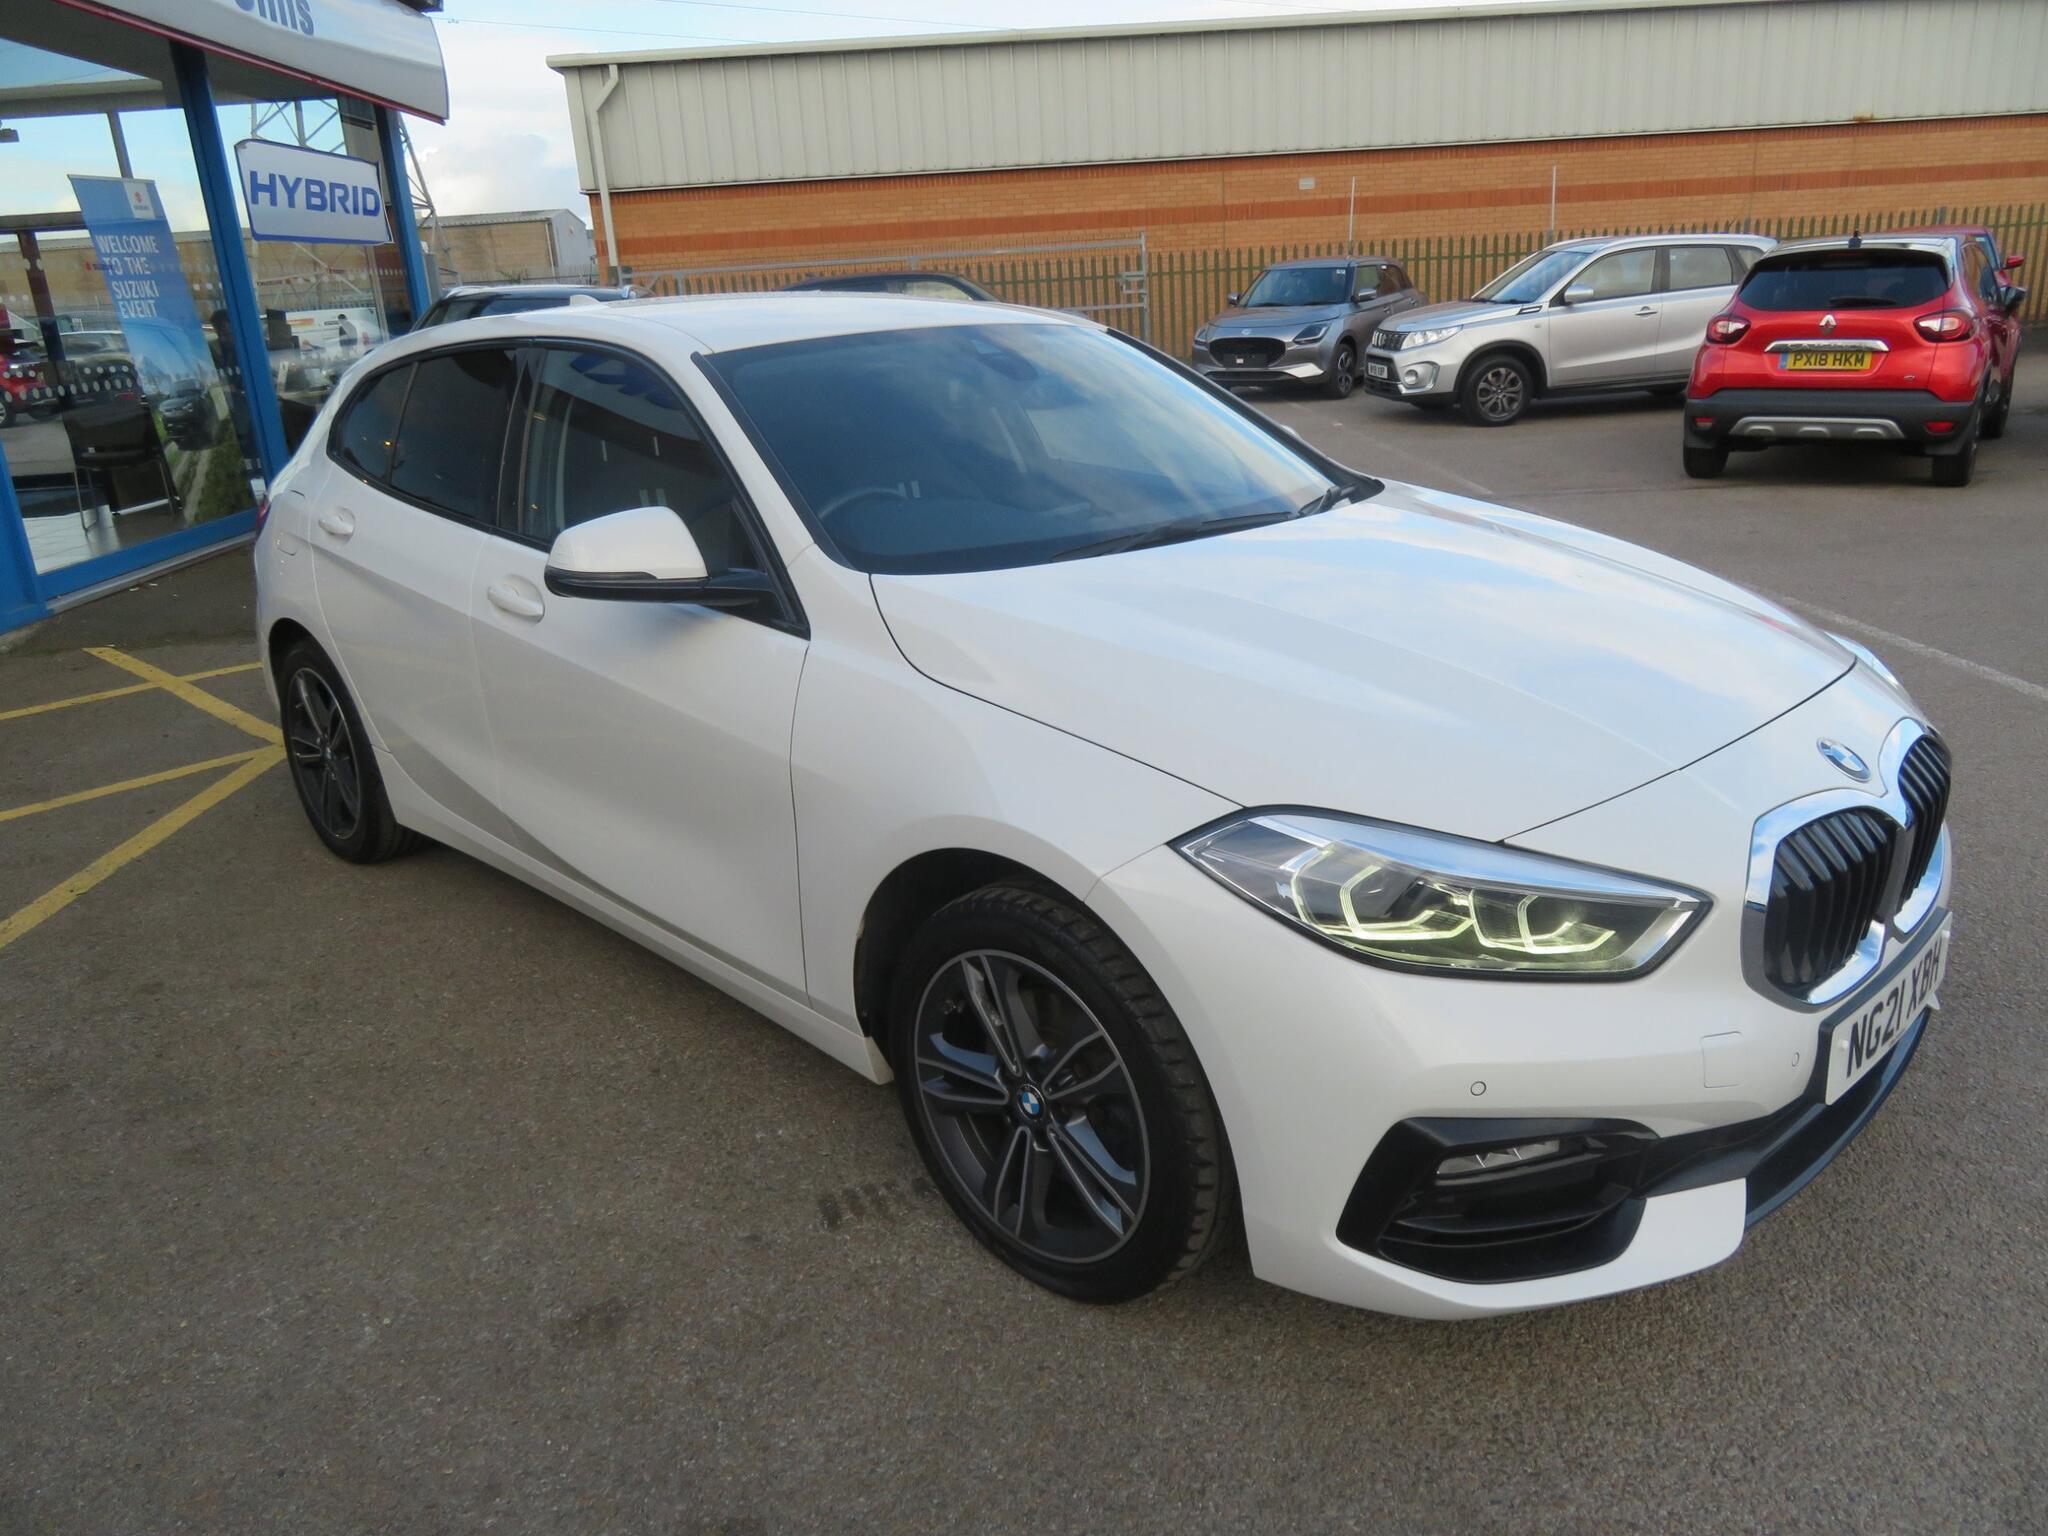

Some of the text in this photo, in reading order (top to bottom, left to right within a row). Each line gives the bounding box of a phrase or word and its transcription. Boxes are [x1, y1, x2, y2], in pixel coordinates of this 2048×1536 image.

[250, 170, 381, 217] HYBRID
[96, 235, 159, 254] WELCOME
[103, 256, 123, 276] TO
[125, 256, 151, 275] THE
[111, 280, 160, 299] SUZUKI
[117, 299, 158, 319] EVENT
[1793, 353, 1866, 367] PX18 HKM
[1847, 979, 1906, 1078] NG21
